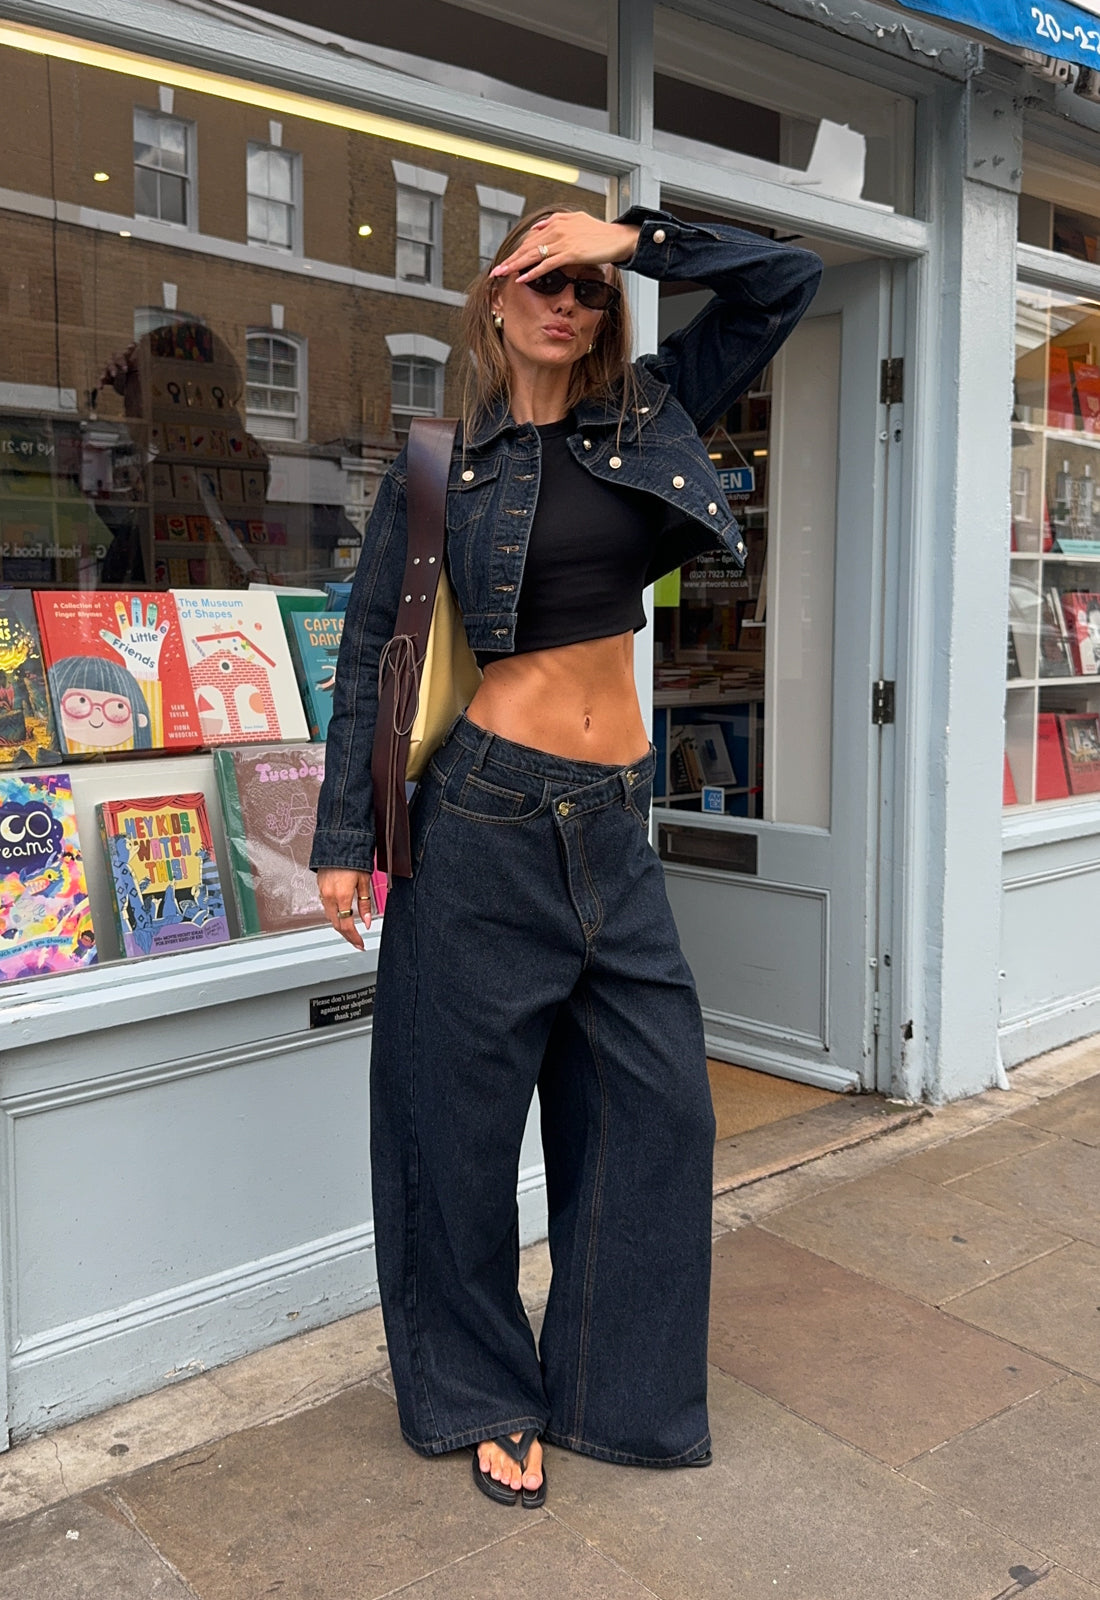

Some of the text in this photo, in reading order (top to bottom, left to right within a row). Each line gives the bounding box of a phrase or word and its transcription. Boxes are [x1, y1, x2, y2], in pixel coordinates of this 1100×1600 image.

[1031, 7, 1100, 55] 20-22
[720, 472, 743, 489] EN
[708, 570, 724, 578] 7923
[727, 570, 742, 578] 7507
[179, 598, 243, 607] The Museum
[182, 609, 233, 619] of Shapes
[304, 618, 345, 631] CAPTA
[130, 633, 159, 643] Little
[112, 638, 156, 669] Friends
[255, 758, 326, 783] Tuesday
[124, 816, 153, 839] HEY
[136, 835, 192, 861] WATCH
[145, 858, 188, 884] THIS!
[312, 999, 330, 1007] Please
[358, 991, 368, 999] your
[320, 1006, 340, 1016] against
[334, 1013, 349, 1021] thank
